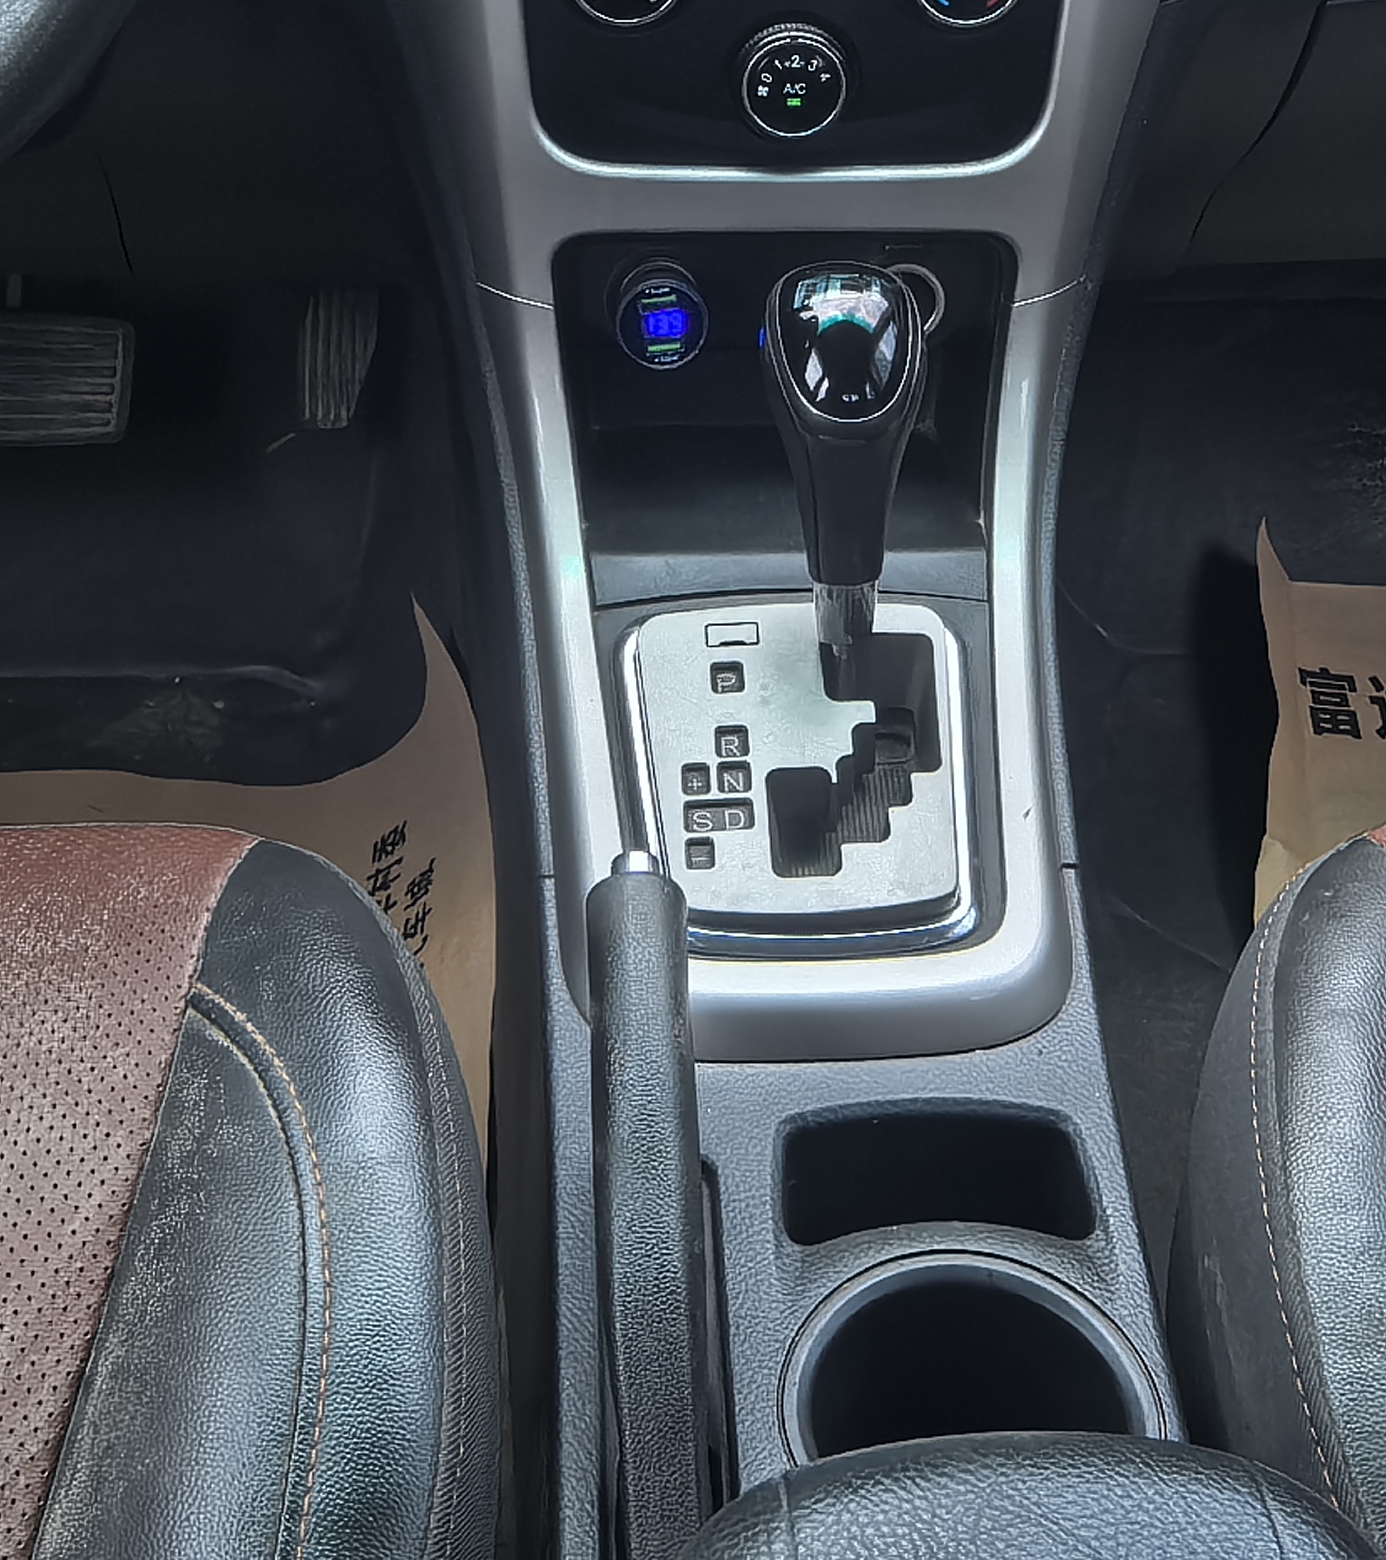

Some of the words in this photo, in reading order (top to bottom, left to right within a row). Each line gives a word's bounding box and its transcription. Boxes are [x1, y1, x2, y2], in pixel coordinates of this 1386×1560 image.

[791, 54, 802, 69] 2
[716, 673, 736, 692] P
[720, 736, 741, 756] R
[722, 772, 746, 791] N
[692, 812, 714, 831] S
[723, 810, 746, 829] D
